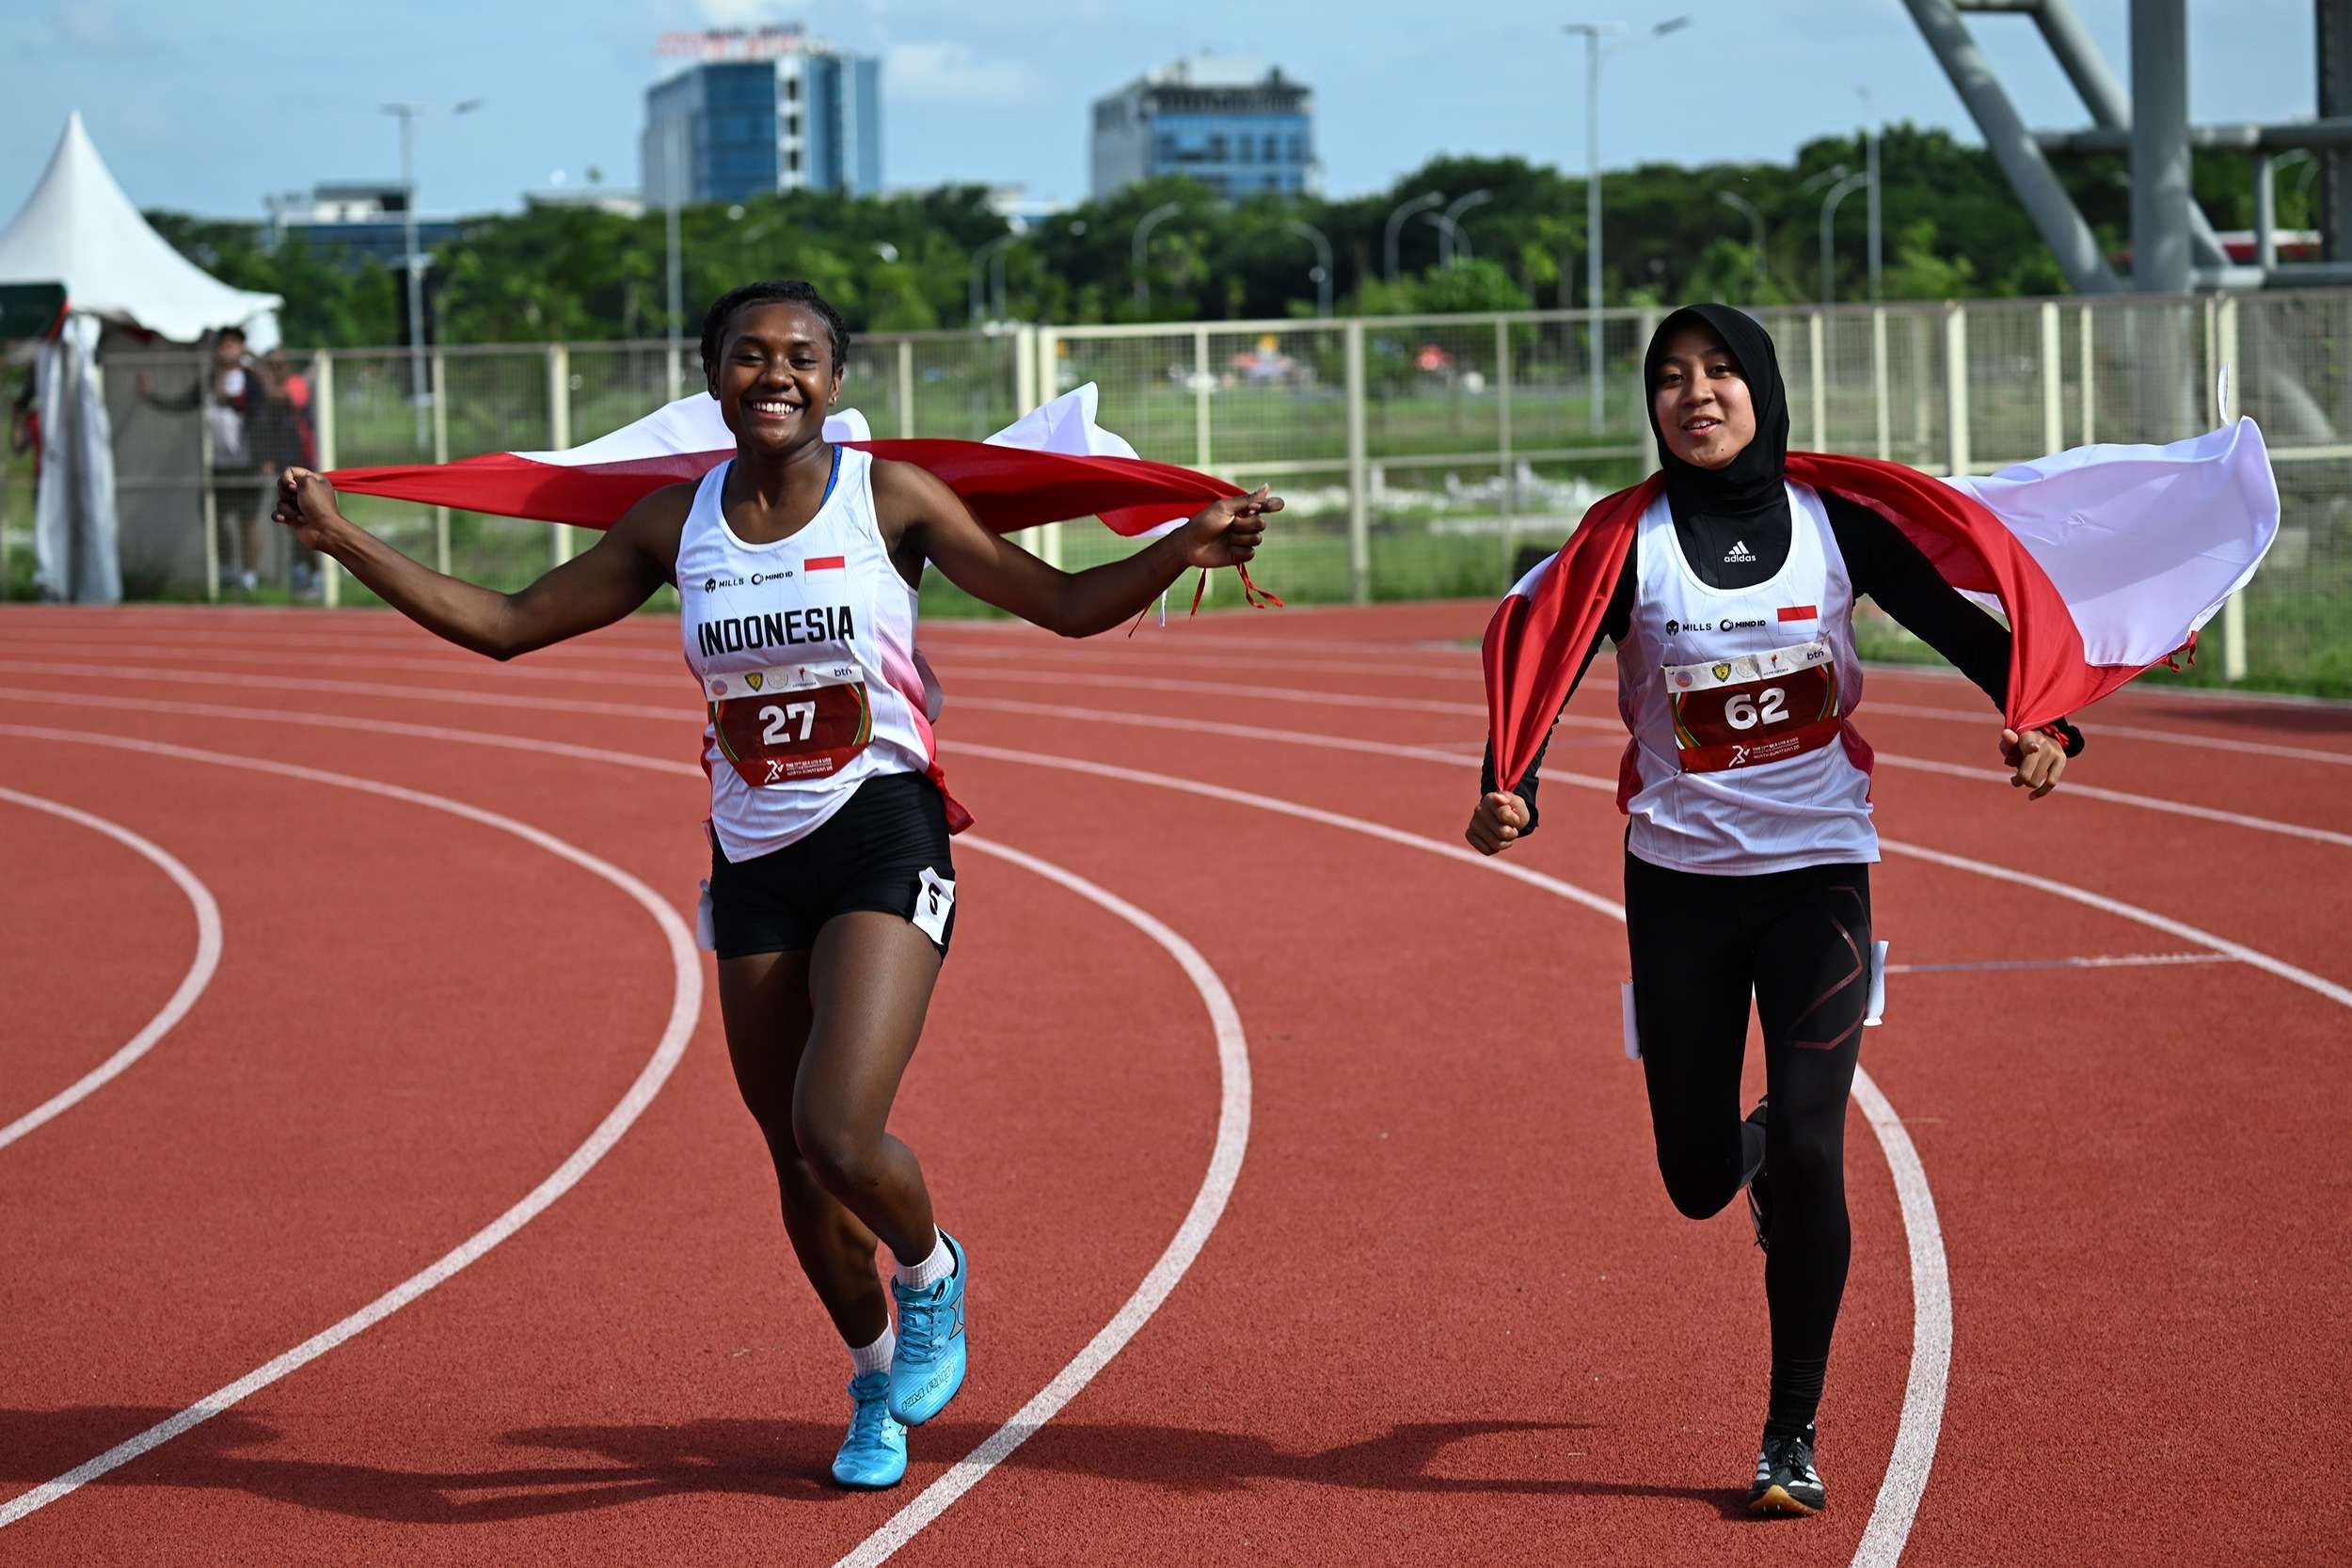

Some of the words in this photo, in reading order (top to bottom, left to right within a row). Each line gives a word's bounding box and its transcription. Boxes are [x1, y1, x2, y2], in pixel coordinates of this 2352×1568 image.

[1724, 554, 1756, 562] adidas
[765, 572, 785, 580] MIND
[785, 570, 793, 578] ID
[719, 577, 744, 588] MILLS
[1682, 622, 1712, 632] MILLS
[1735, 620, 1756, 629] MIND
[1756, 619, 1766, 627] ID
[698, 606, 855, 657] INDONESIA
[1806, 650, 1824, 660] btn
[834, 667, 852, 677] btn
[1724, 688, 1789, 730] 62
[758, 701, 816, 746] 27
